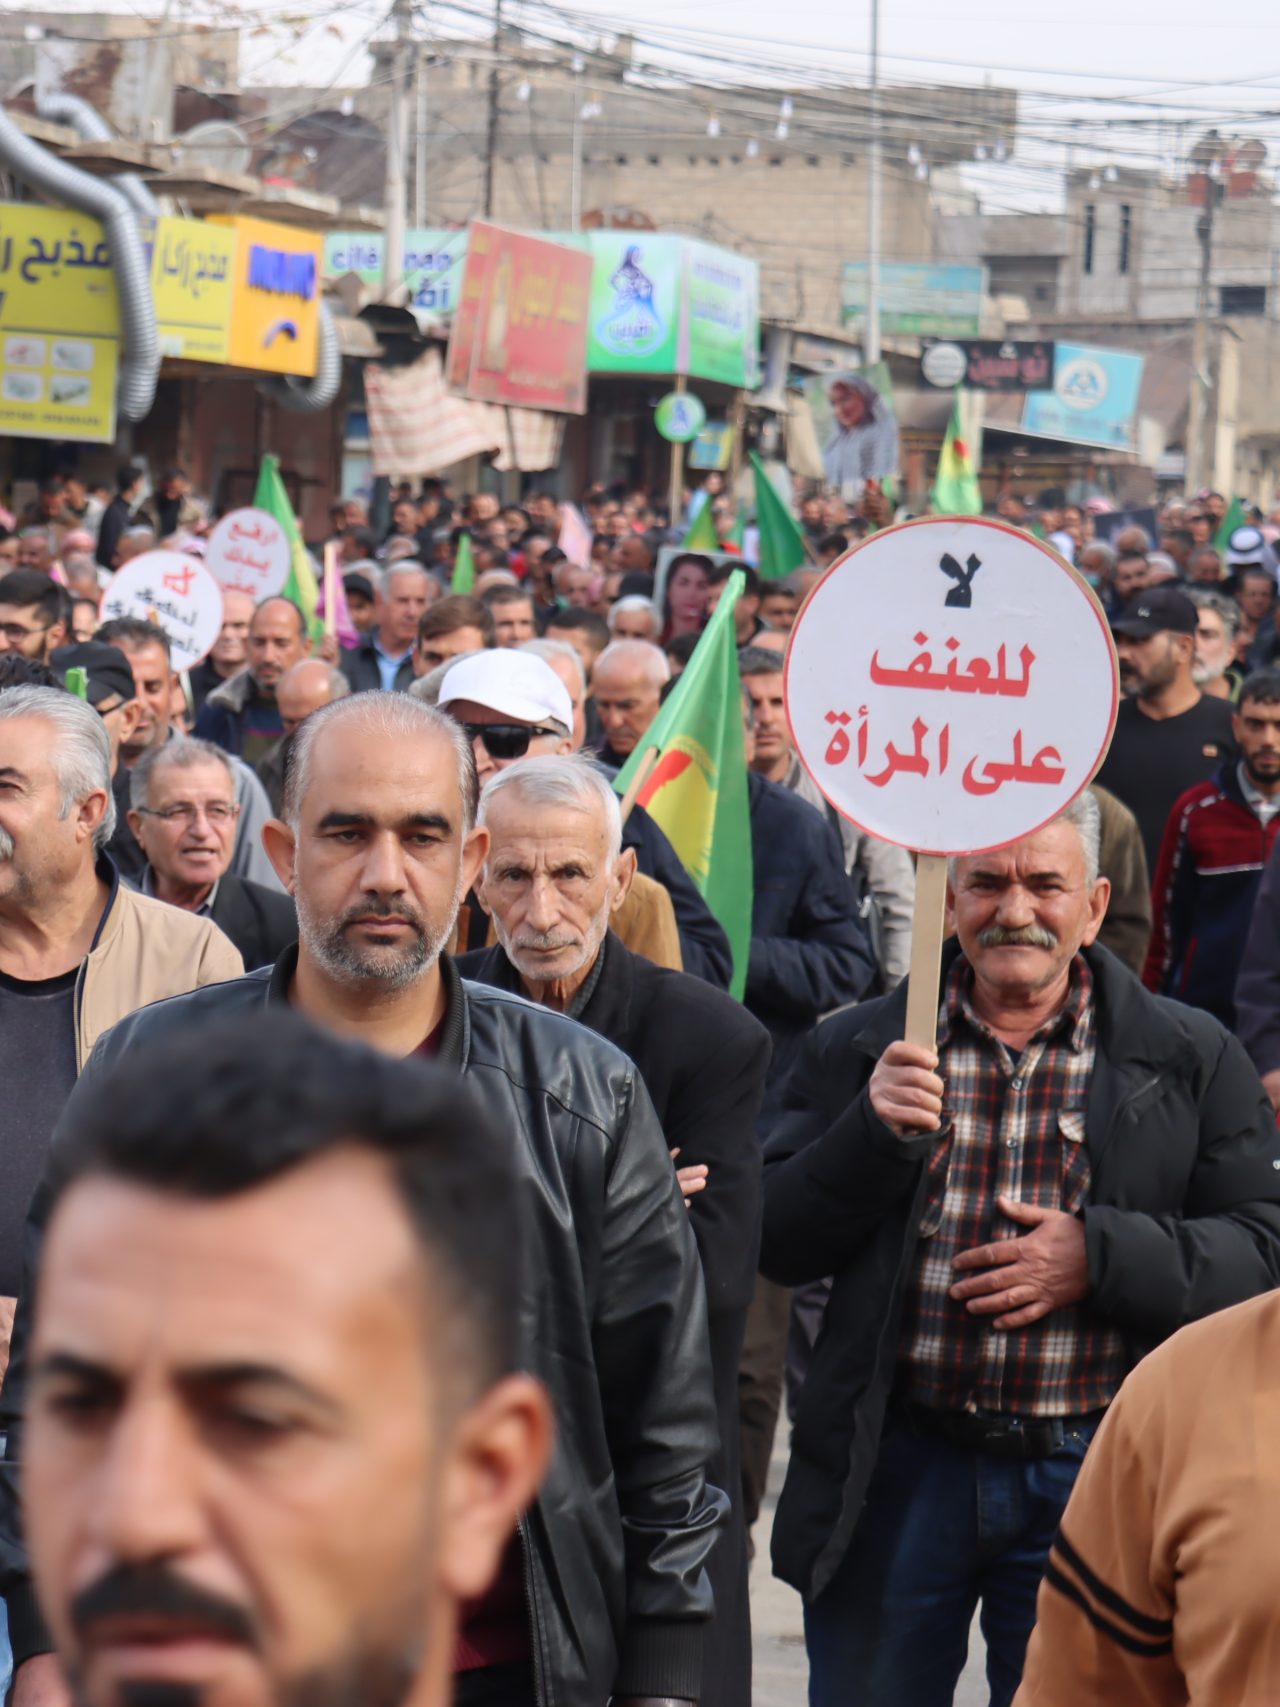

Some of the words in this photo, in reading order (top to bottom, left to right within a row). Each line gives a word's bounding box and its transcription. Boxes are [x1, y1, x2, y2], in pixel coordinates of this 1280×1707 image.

[939, 552, 982, 608] لا
[869, 630, 1036, 697] للعنف
[823, 704, 950, 788] المرأة
[961, 727, 1066, 796] على
